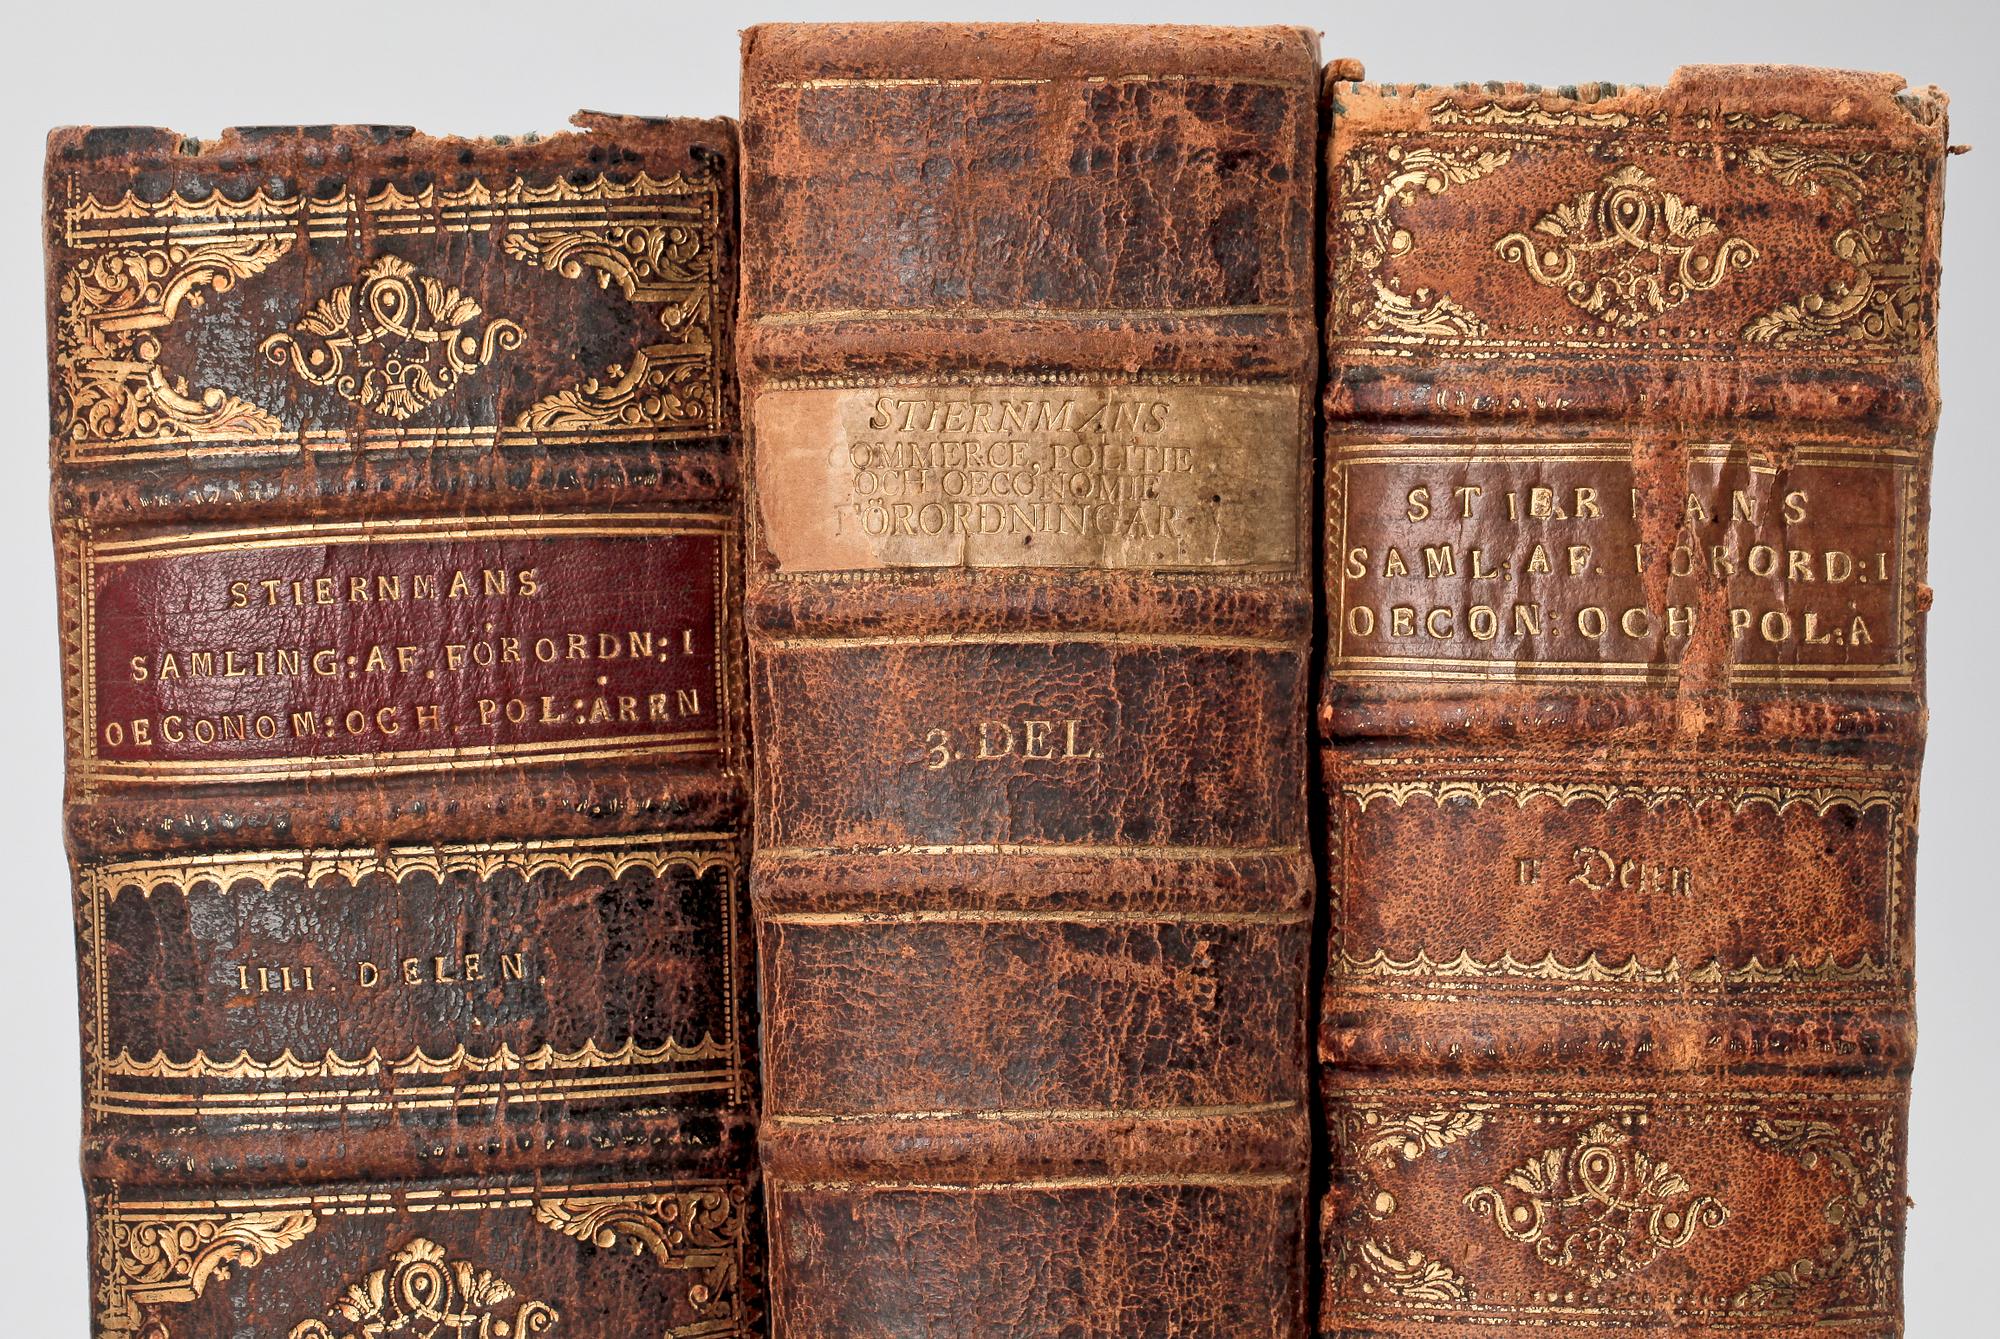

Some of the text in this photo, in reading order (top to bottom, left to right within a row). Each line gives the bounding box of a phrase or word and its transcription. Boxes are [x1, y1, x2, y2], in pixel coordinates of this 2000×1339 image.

[868, 396, 1170, 434] STIERNMANS
[1051, 443, 1194, 475] POLITIE
[852, 468, 929, 497] OCH
[230, 568, 538, 609] STIERNMANS
[925, 719, 1105, 771] 3. DEL.
